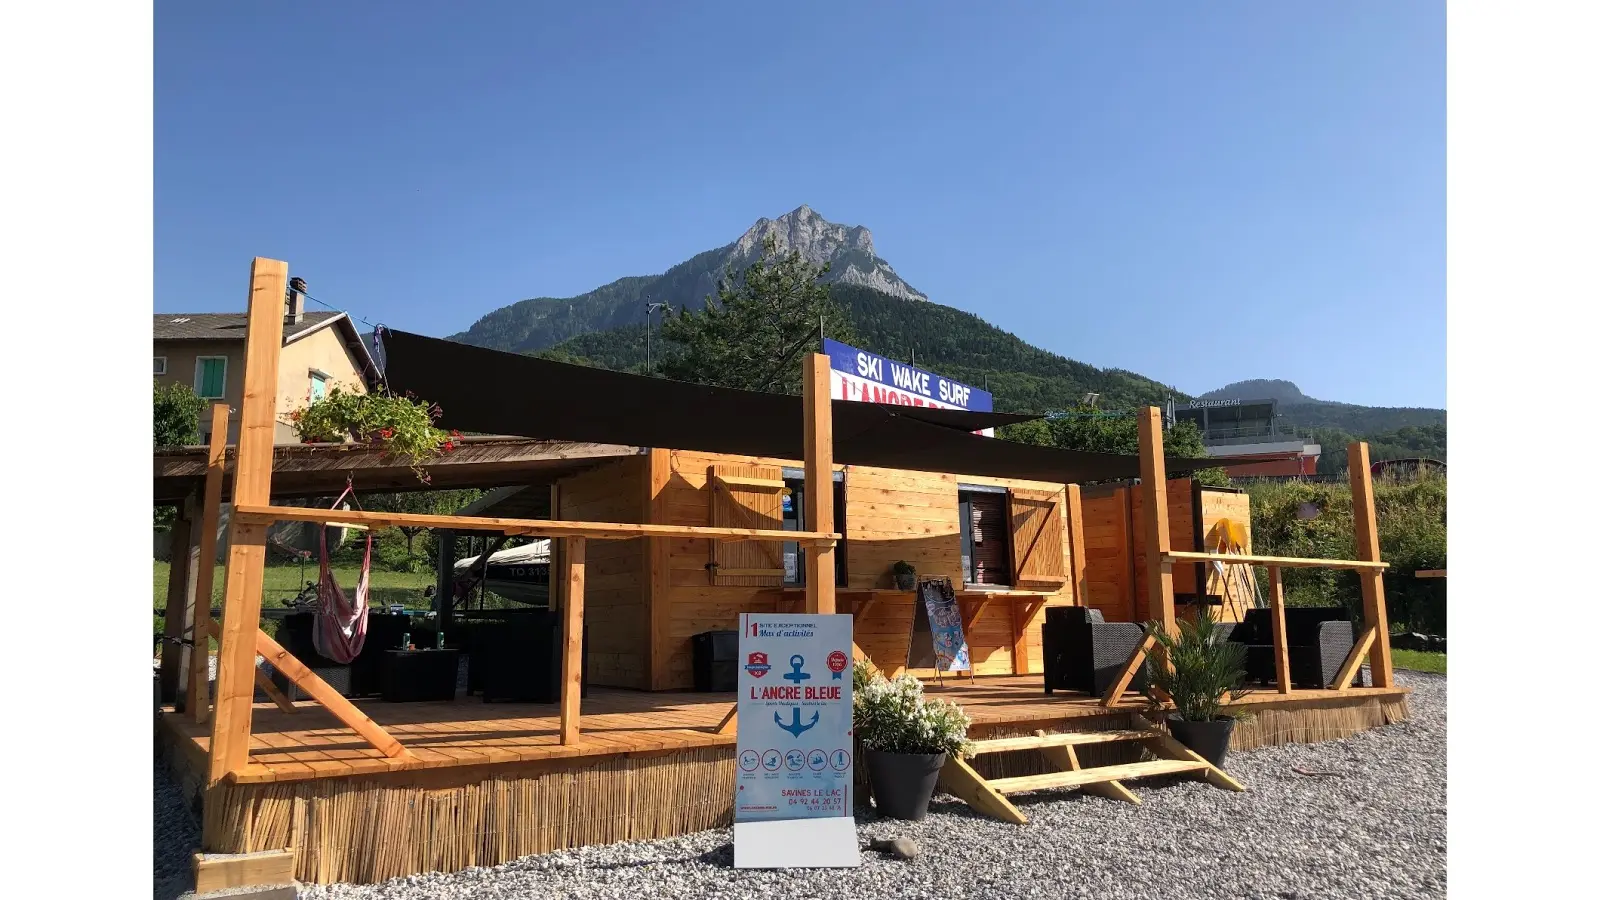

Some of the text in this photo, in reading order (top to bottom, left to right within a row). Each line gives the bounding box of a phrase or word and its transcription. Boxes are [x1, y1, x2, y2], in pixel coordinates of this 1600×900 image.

[857, 352, 971, 407] SKI WAKE SURF
[1189, 397, 1241, 409] Restaurant
[528, 566, 550, 576] 313
[750, 622, 758, 637] 1
[750, 686, 841, 700] L'ANCRE BLEUE
[781, 789, 841, 797] SAVINES LE LAC
[833, 797, 842, 805] 57
